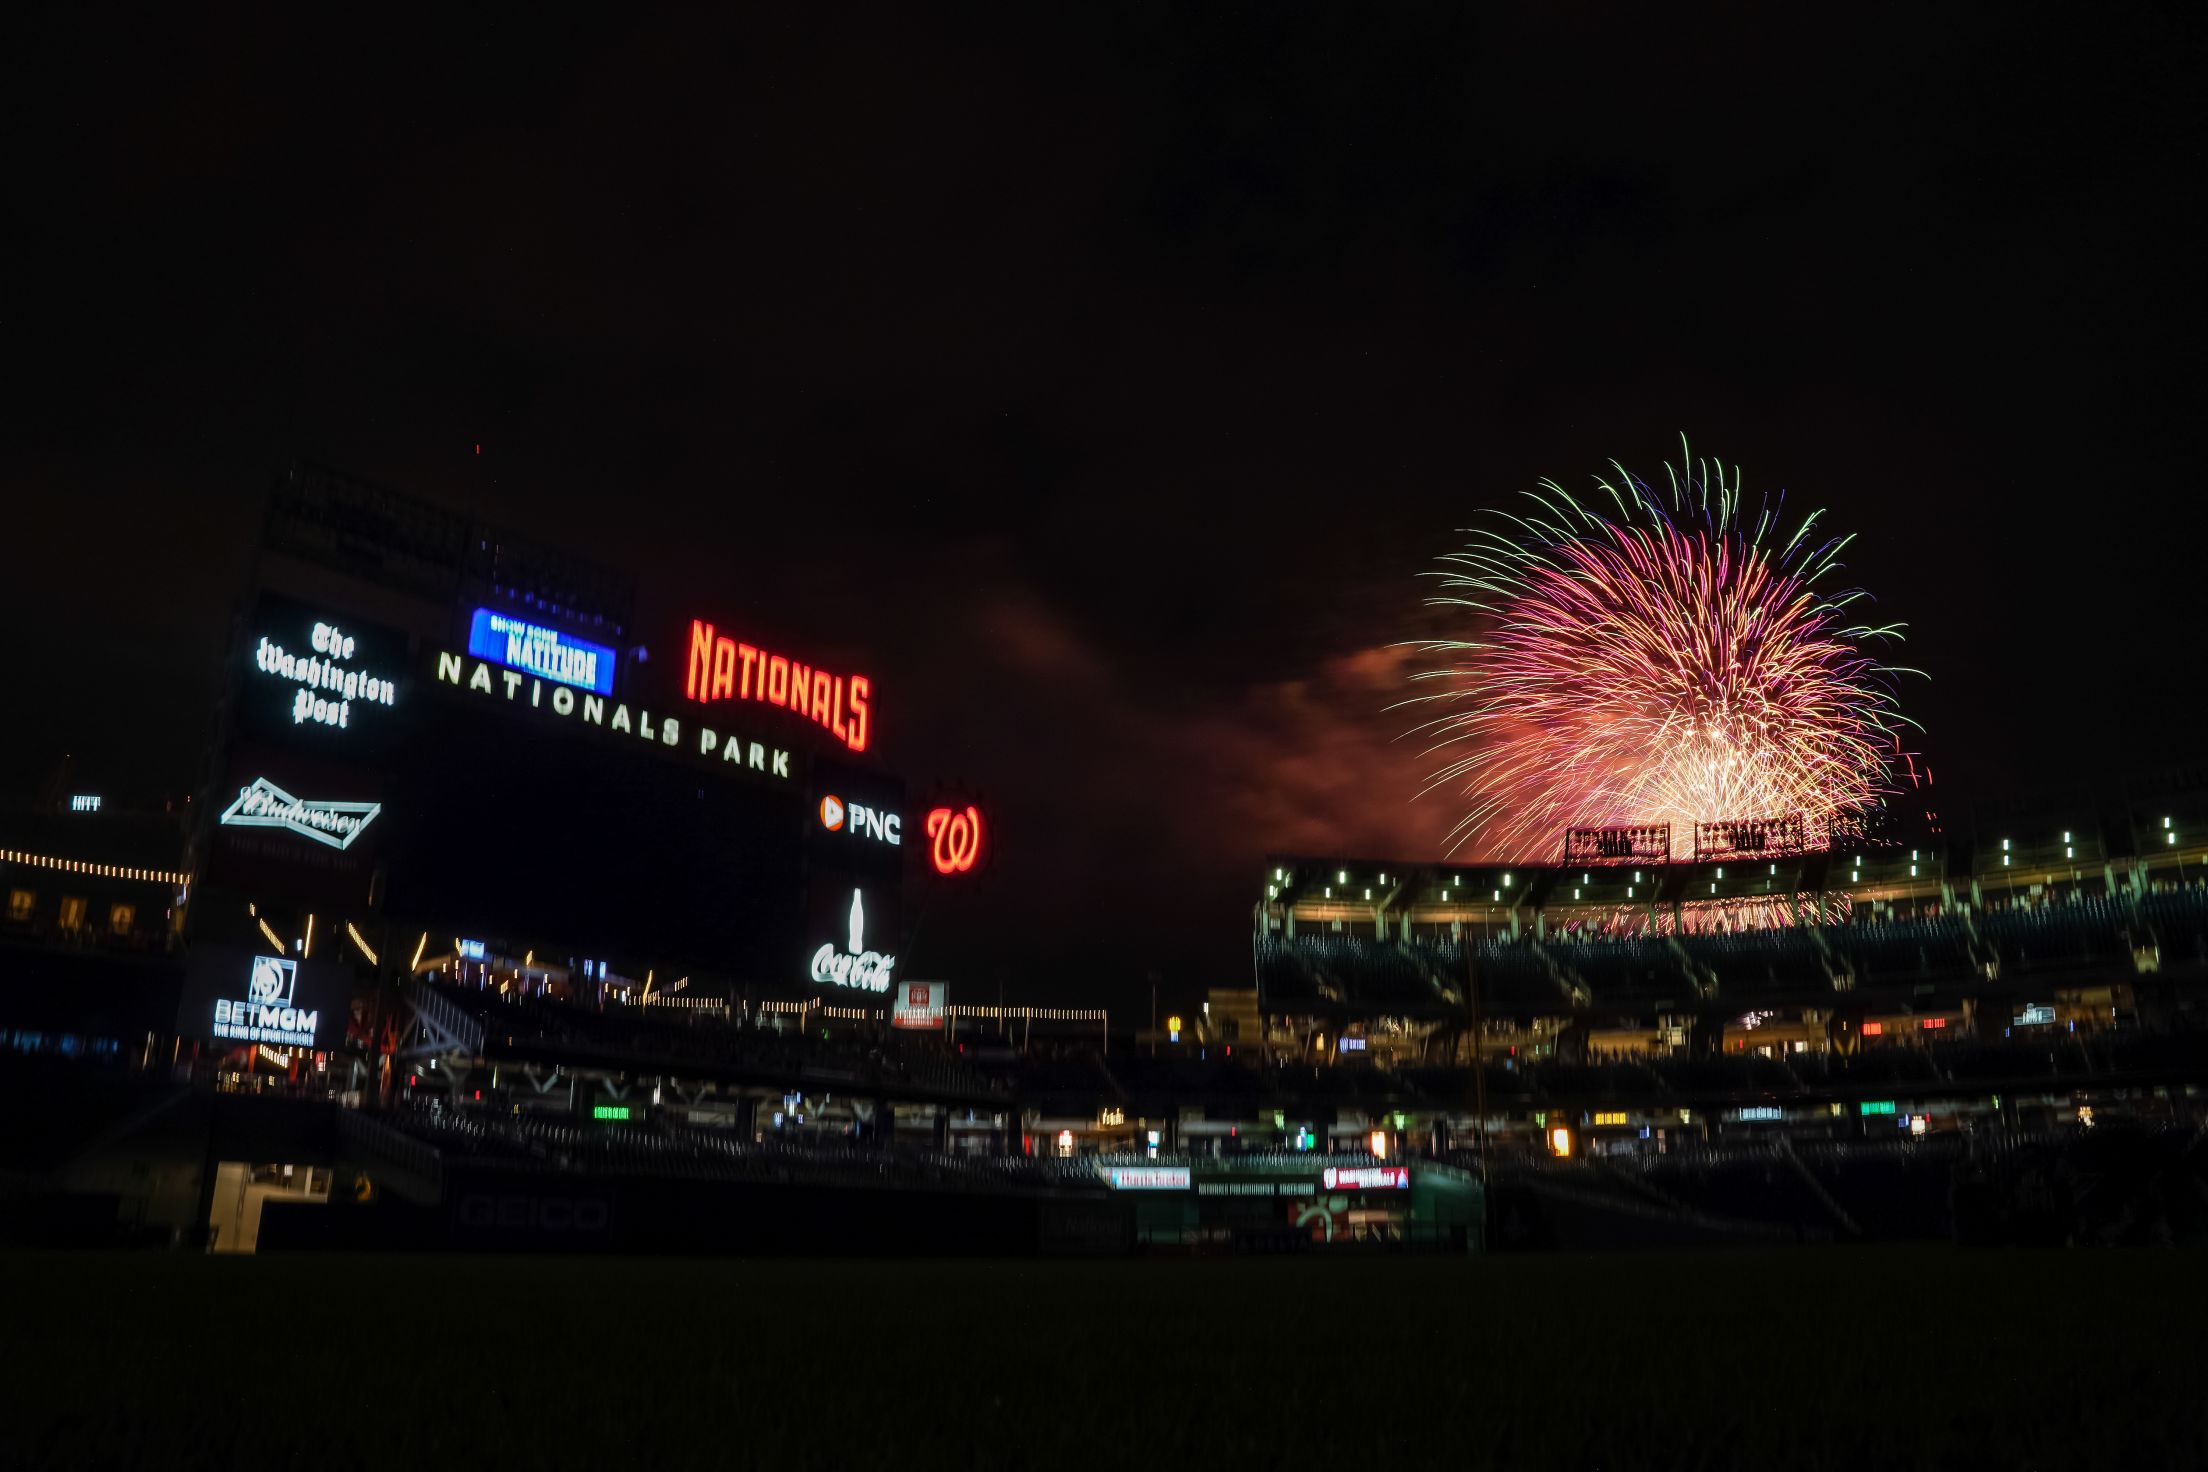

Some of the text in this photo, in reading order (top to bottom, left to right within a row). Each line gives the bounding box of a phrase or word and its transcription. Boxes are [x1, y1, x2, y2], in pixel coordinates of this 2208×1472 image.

[311, 621, 355, 660] The
[506, 632, 597, 691] NATITUDE
[256, 636, 395, 706] Washington
[687, 618, 870, 752] NATIONALS
[293, 687, 349, 729] Post
[438, 649, 790, 779] NATIONALS PARK
[848, 802, 901, 845] PNC
[215, 998, 318, 1034] BETMGM
